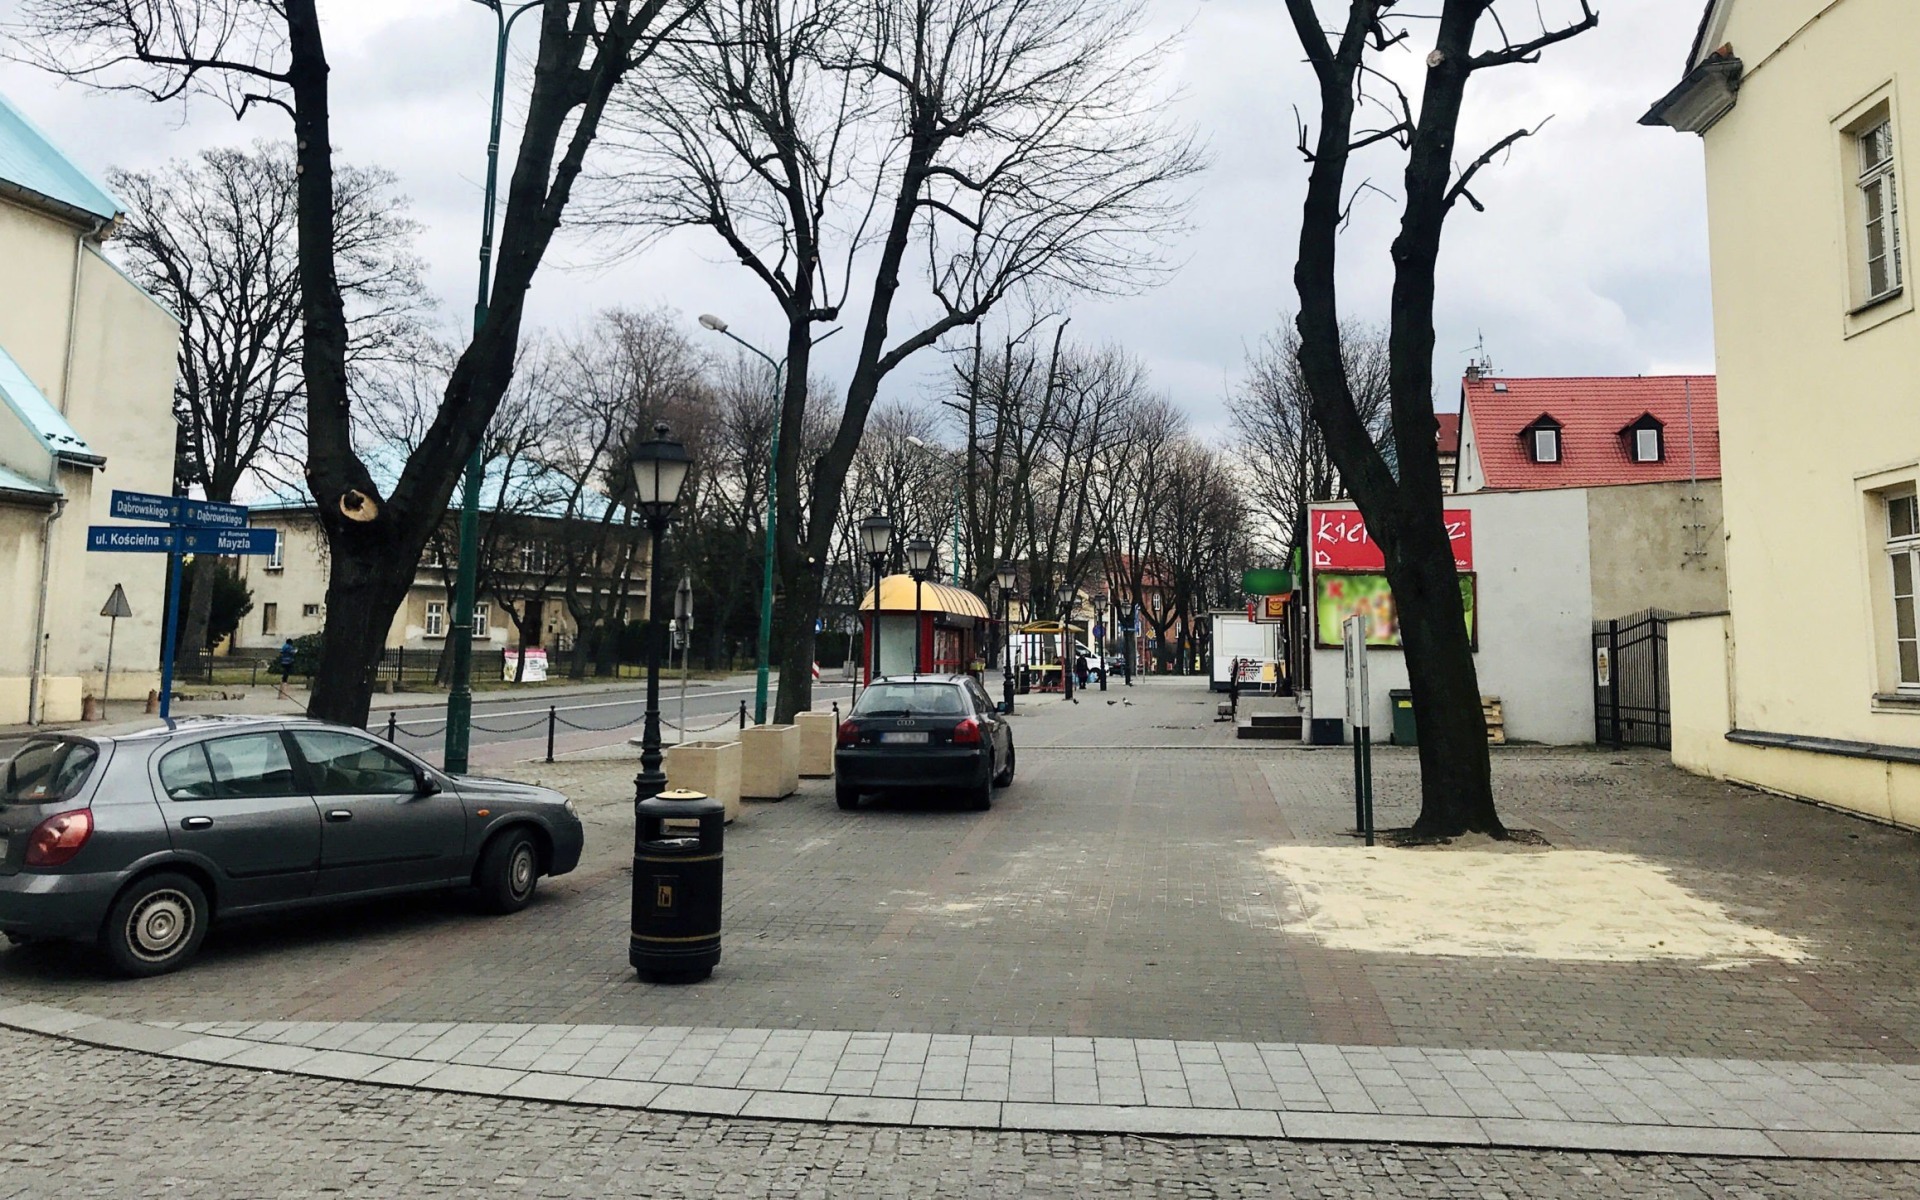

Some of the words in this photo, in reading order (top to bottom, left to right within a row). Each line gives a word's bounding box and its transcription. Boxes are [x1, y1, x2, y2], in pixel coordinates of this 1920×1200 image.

[117, 500, 169, 518] Dąbrowskiego
[196, 509, 243, 527] Dąbrowskiego
[95, 533, 107, 545] ul.
[110, 532, 159, 546] Kościelna
[217, 537, 251, 551] Mayzla
